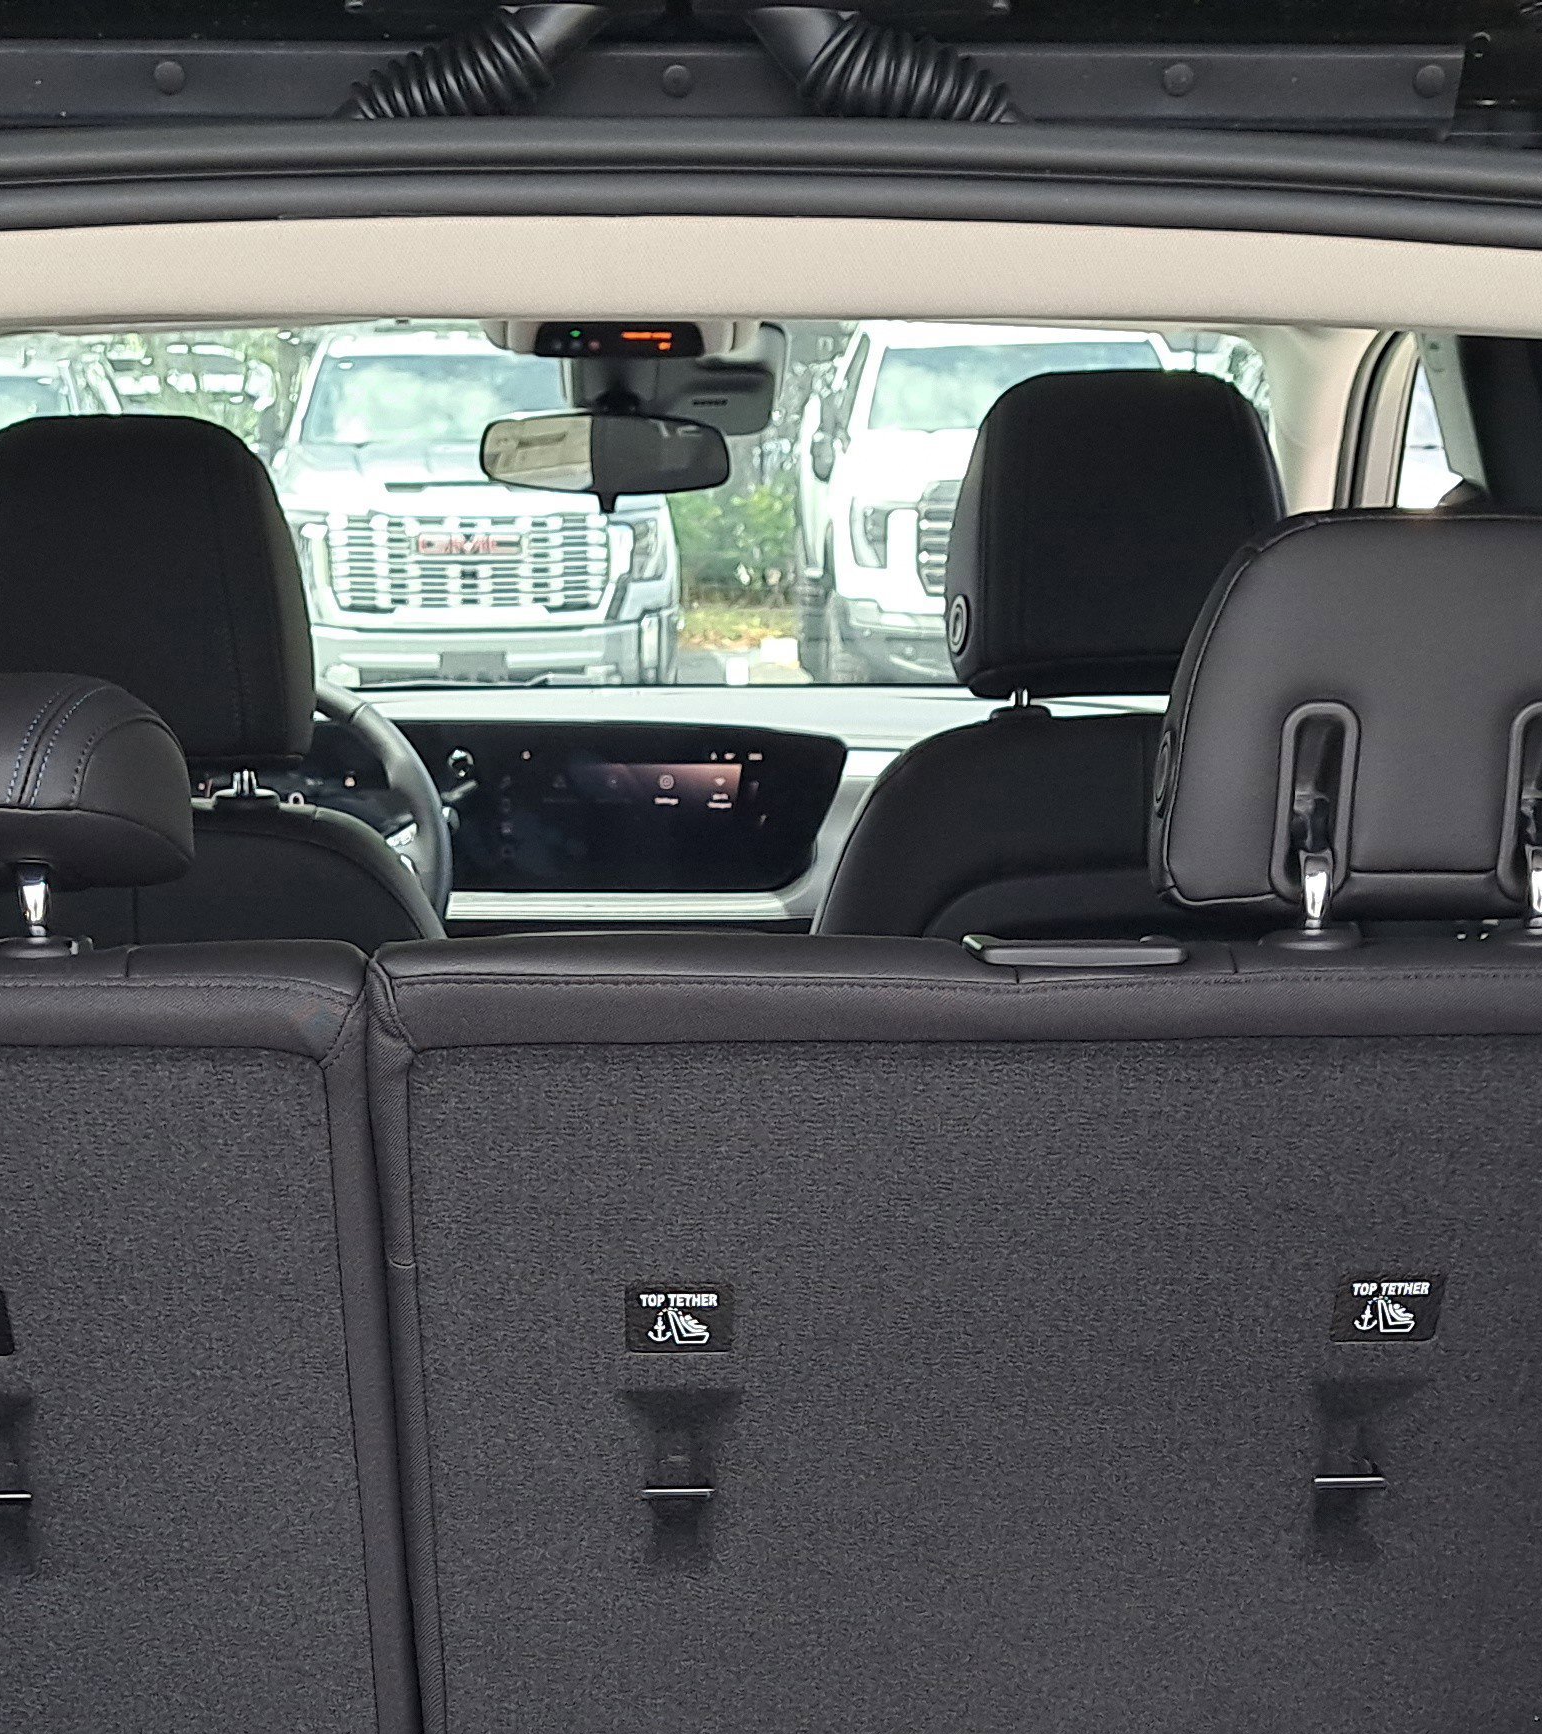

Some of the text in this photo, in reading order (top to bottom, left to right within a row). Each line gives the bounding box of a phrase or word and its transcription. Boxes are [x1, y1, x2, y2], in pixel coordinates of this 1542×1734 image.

[1352, 1281, 1430, 1296] TOP TETHER
[639, 1293, 718, 1307] TOP TETHER
